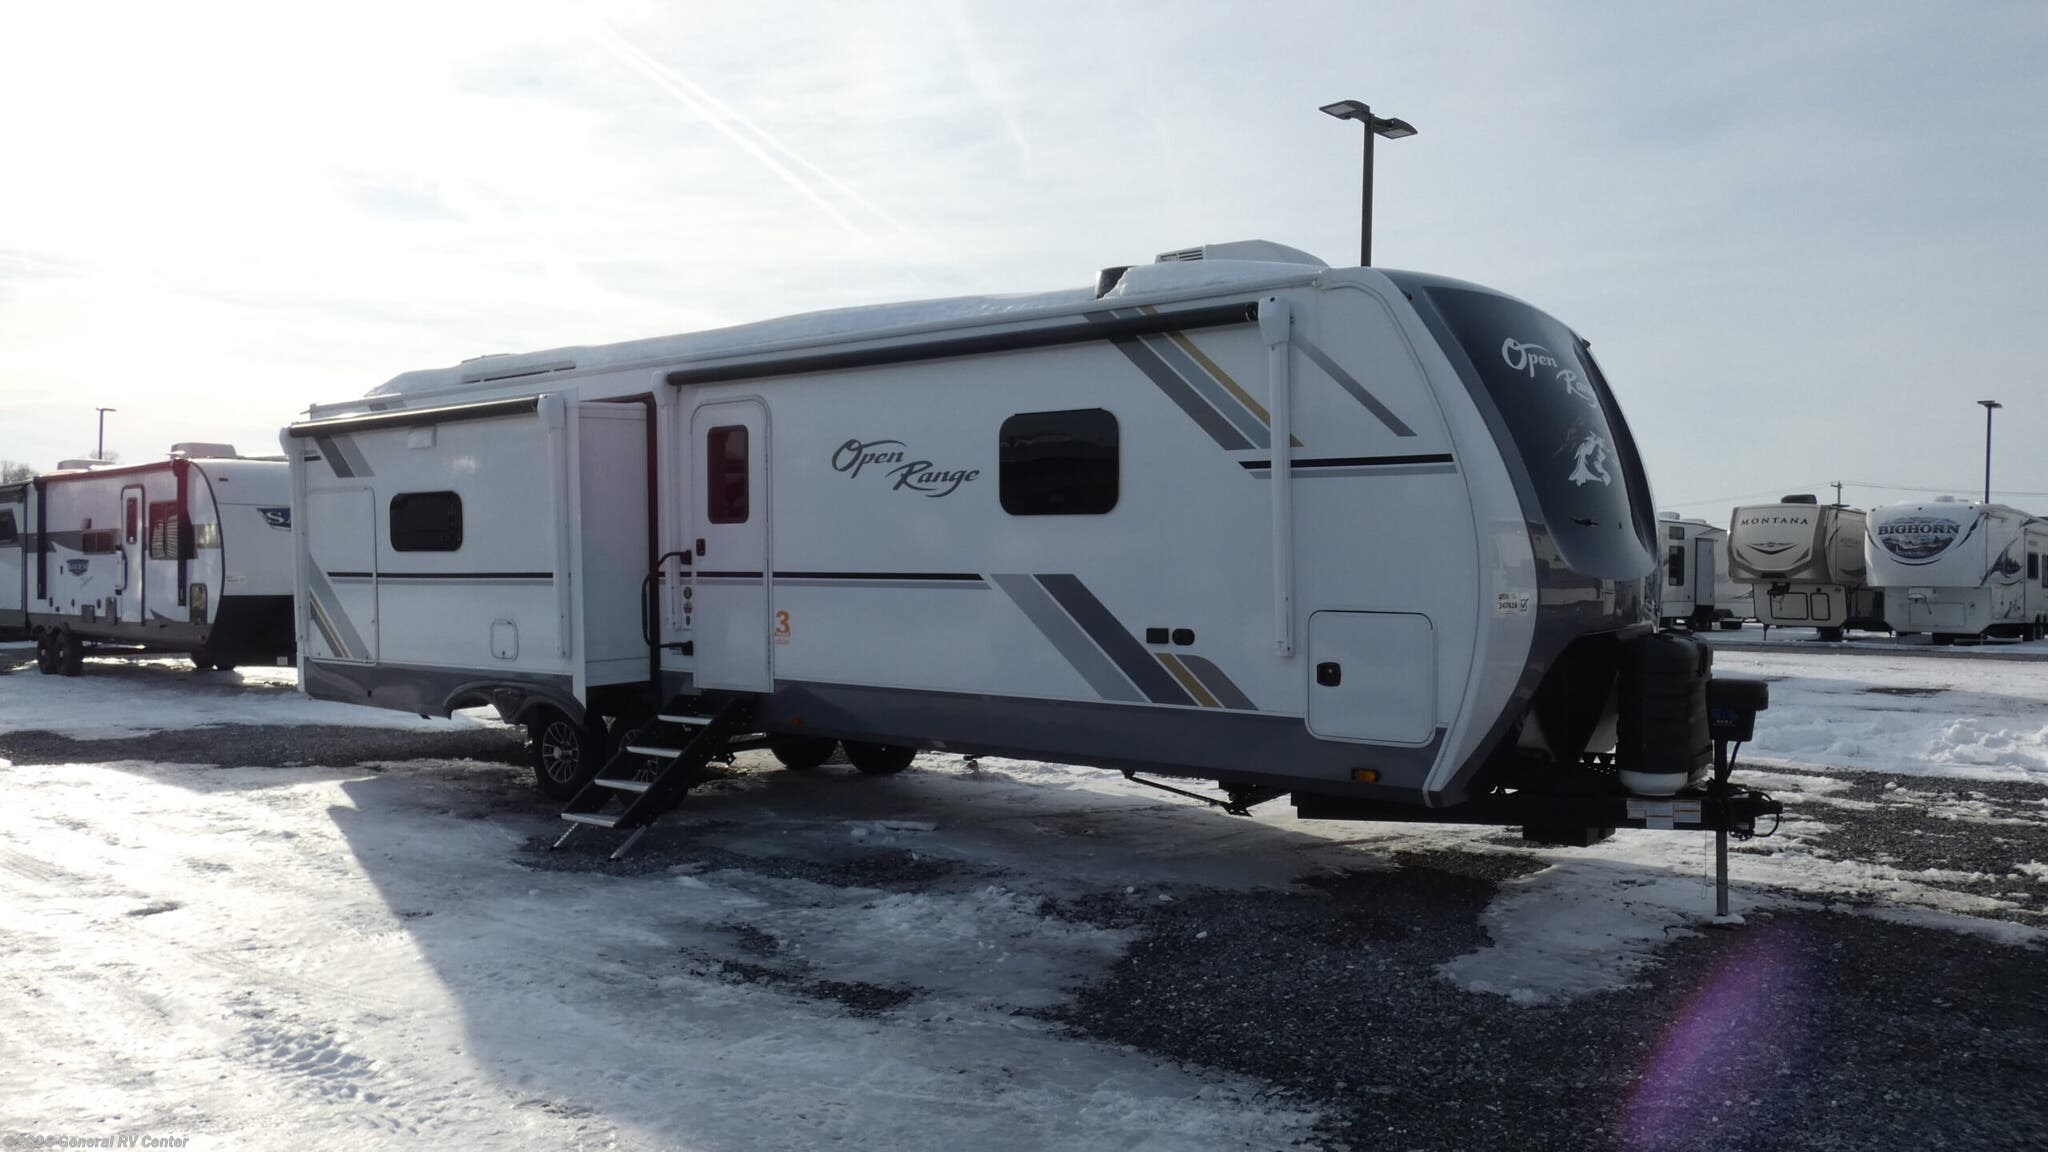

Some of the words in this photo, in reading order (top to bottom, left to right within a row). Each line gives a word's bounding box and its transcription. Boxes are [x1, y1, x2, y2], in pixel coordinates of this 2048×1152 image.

[1502, 337, 1558, 378] Open
[831, 438, 907, 479] Open
[885, 460, 980, 498] Range
[1740, 516, 1809, 526] MONTANA
[1878, 524, 1960, 536] BIGHORN
[775, 610, 790, 633] 3
